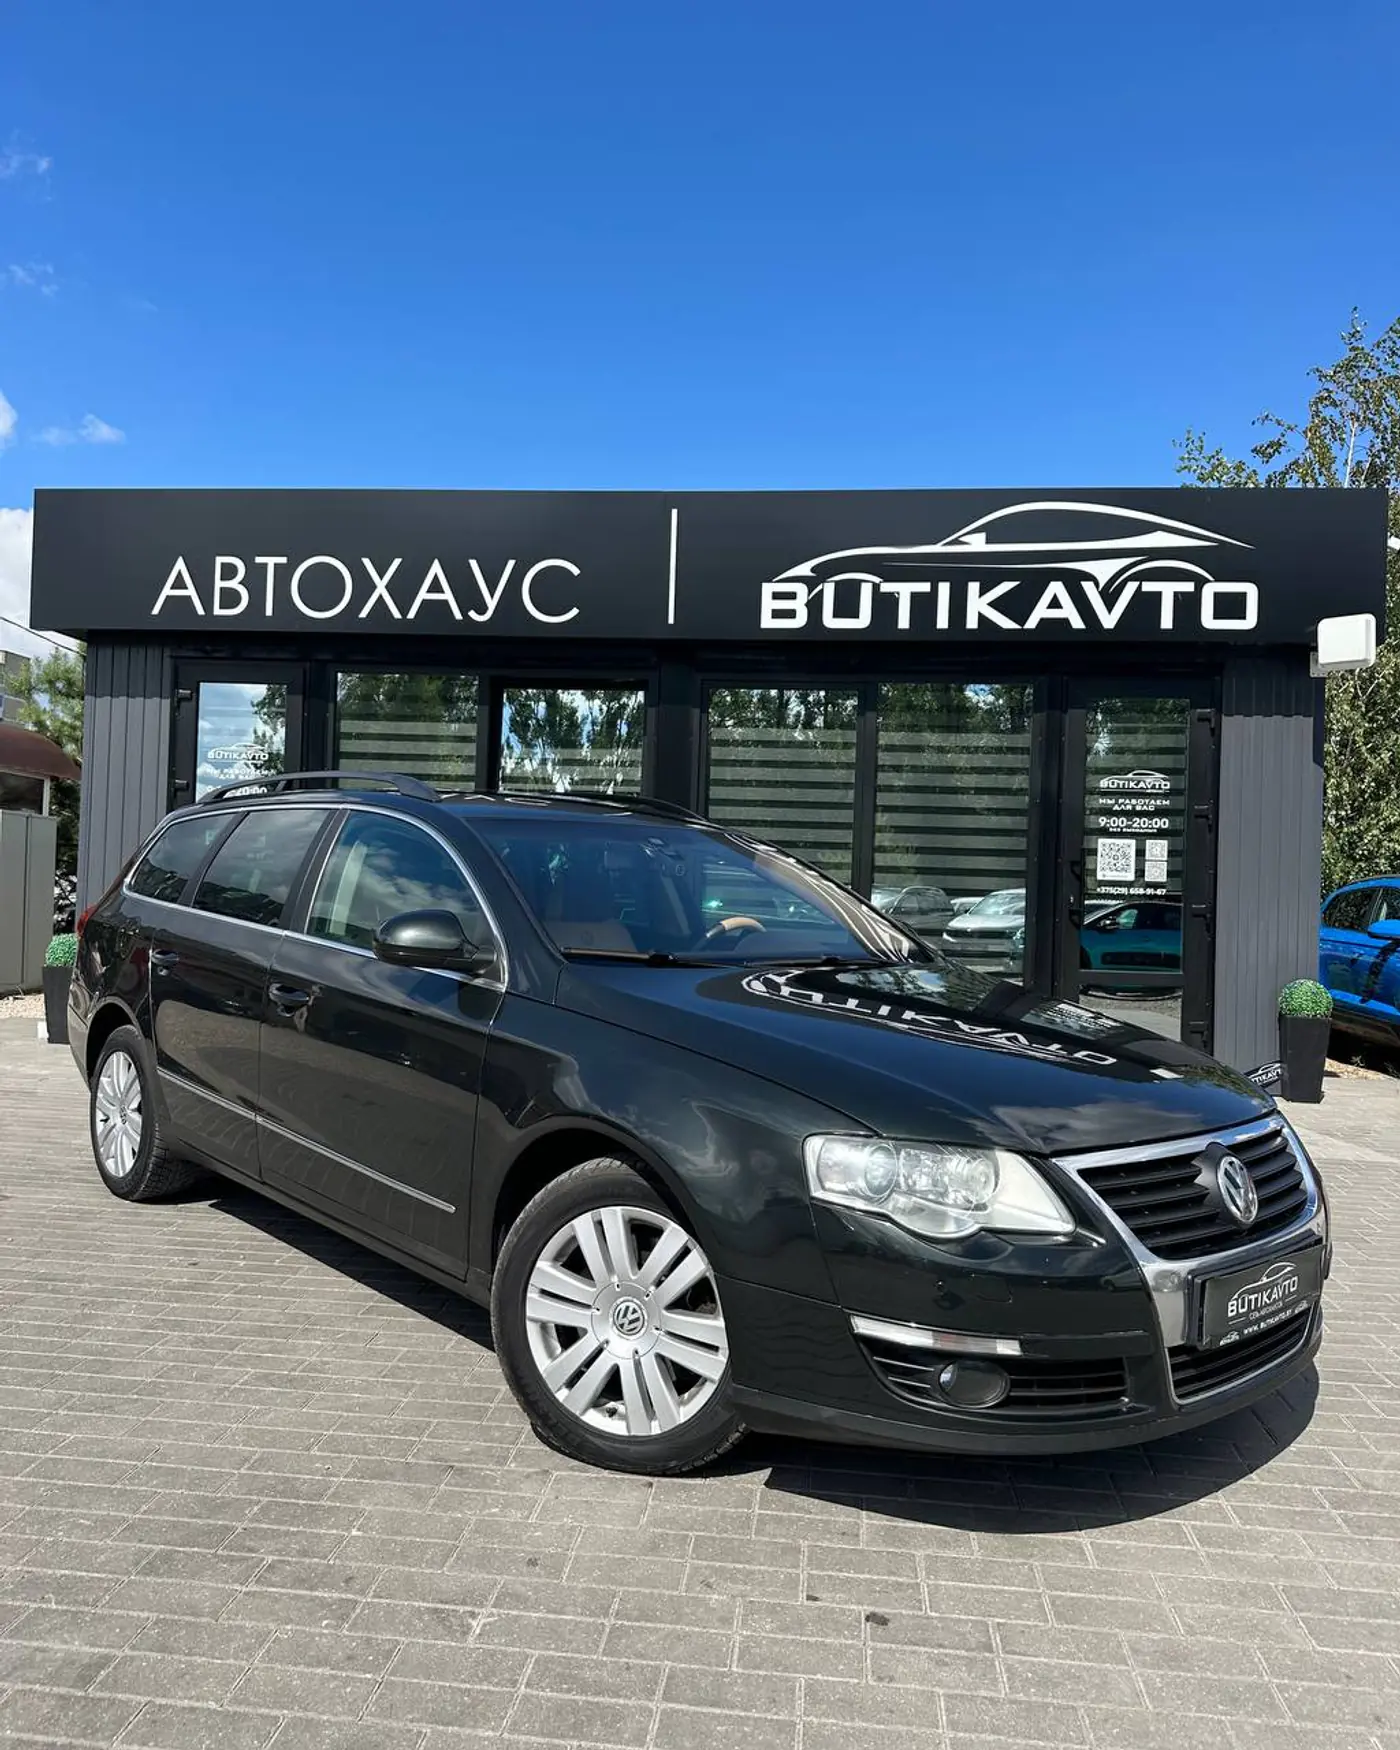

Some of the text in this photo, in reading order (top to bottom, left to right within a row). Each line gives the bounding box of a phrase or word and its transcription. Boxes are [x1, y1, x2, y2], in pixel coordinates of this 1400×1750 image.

[150, 555, 582, 624] АВТОХАУС
[760, 580, 1260, 631] BUTIKAVTO
[1099, 780, 1171, 789] BUTIKAVTO
[1118, 798, 1171, 806] РАБОТАЕМ
[1099, 816, 1169, 828] 9:00-20:00
[1227, 1275, 1299, 1318] BUTIKAVTO
